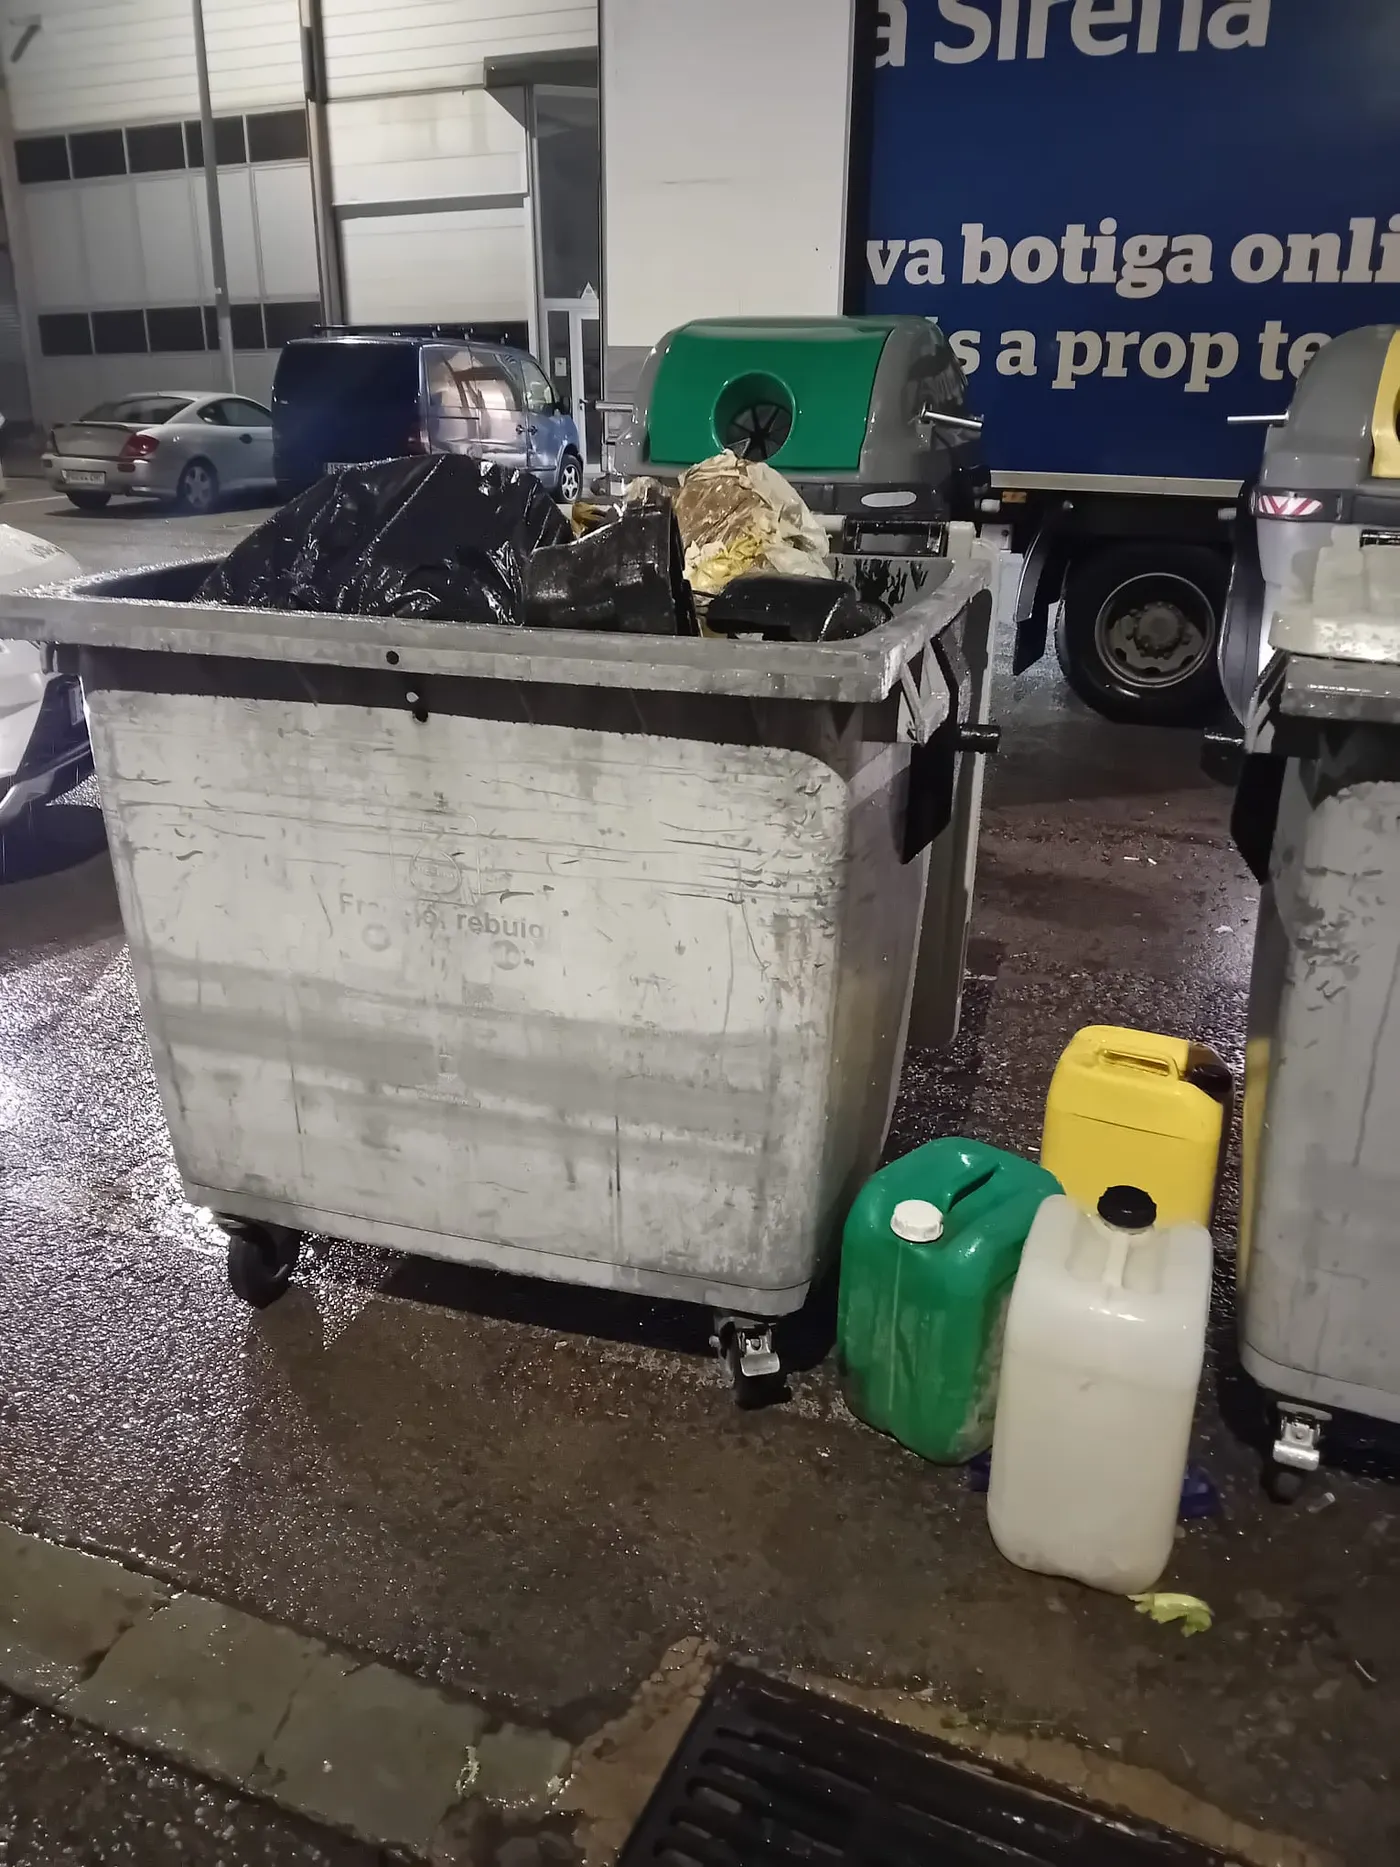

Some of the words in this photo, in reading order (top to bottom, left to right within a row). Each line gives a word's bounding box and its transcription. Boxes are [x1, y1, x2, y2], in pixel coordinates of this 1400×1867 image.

[934, 0, 1271, 64] Sirena
[865, 237, 946, 285] va
[961, 217, 1213, 299] botiga
[1231, 213, 1400, 284] onli
[996, 329, 1038, 376] a
[1051, 328, 1239, 392] prop
